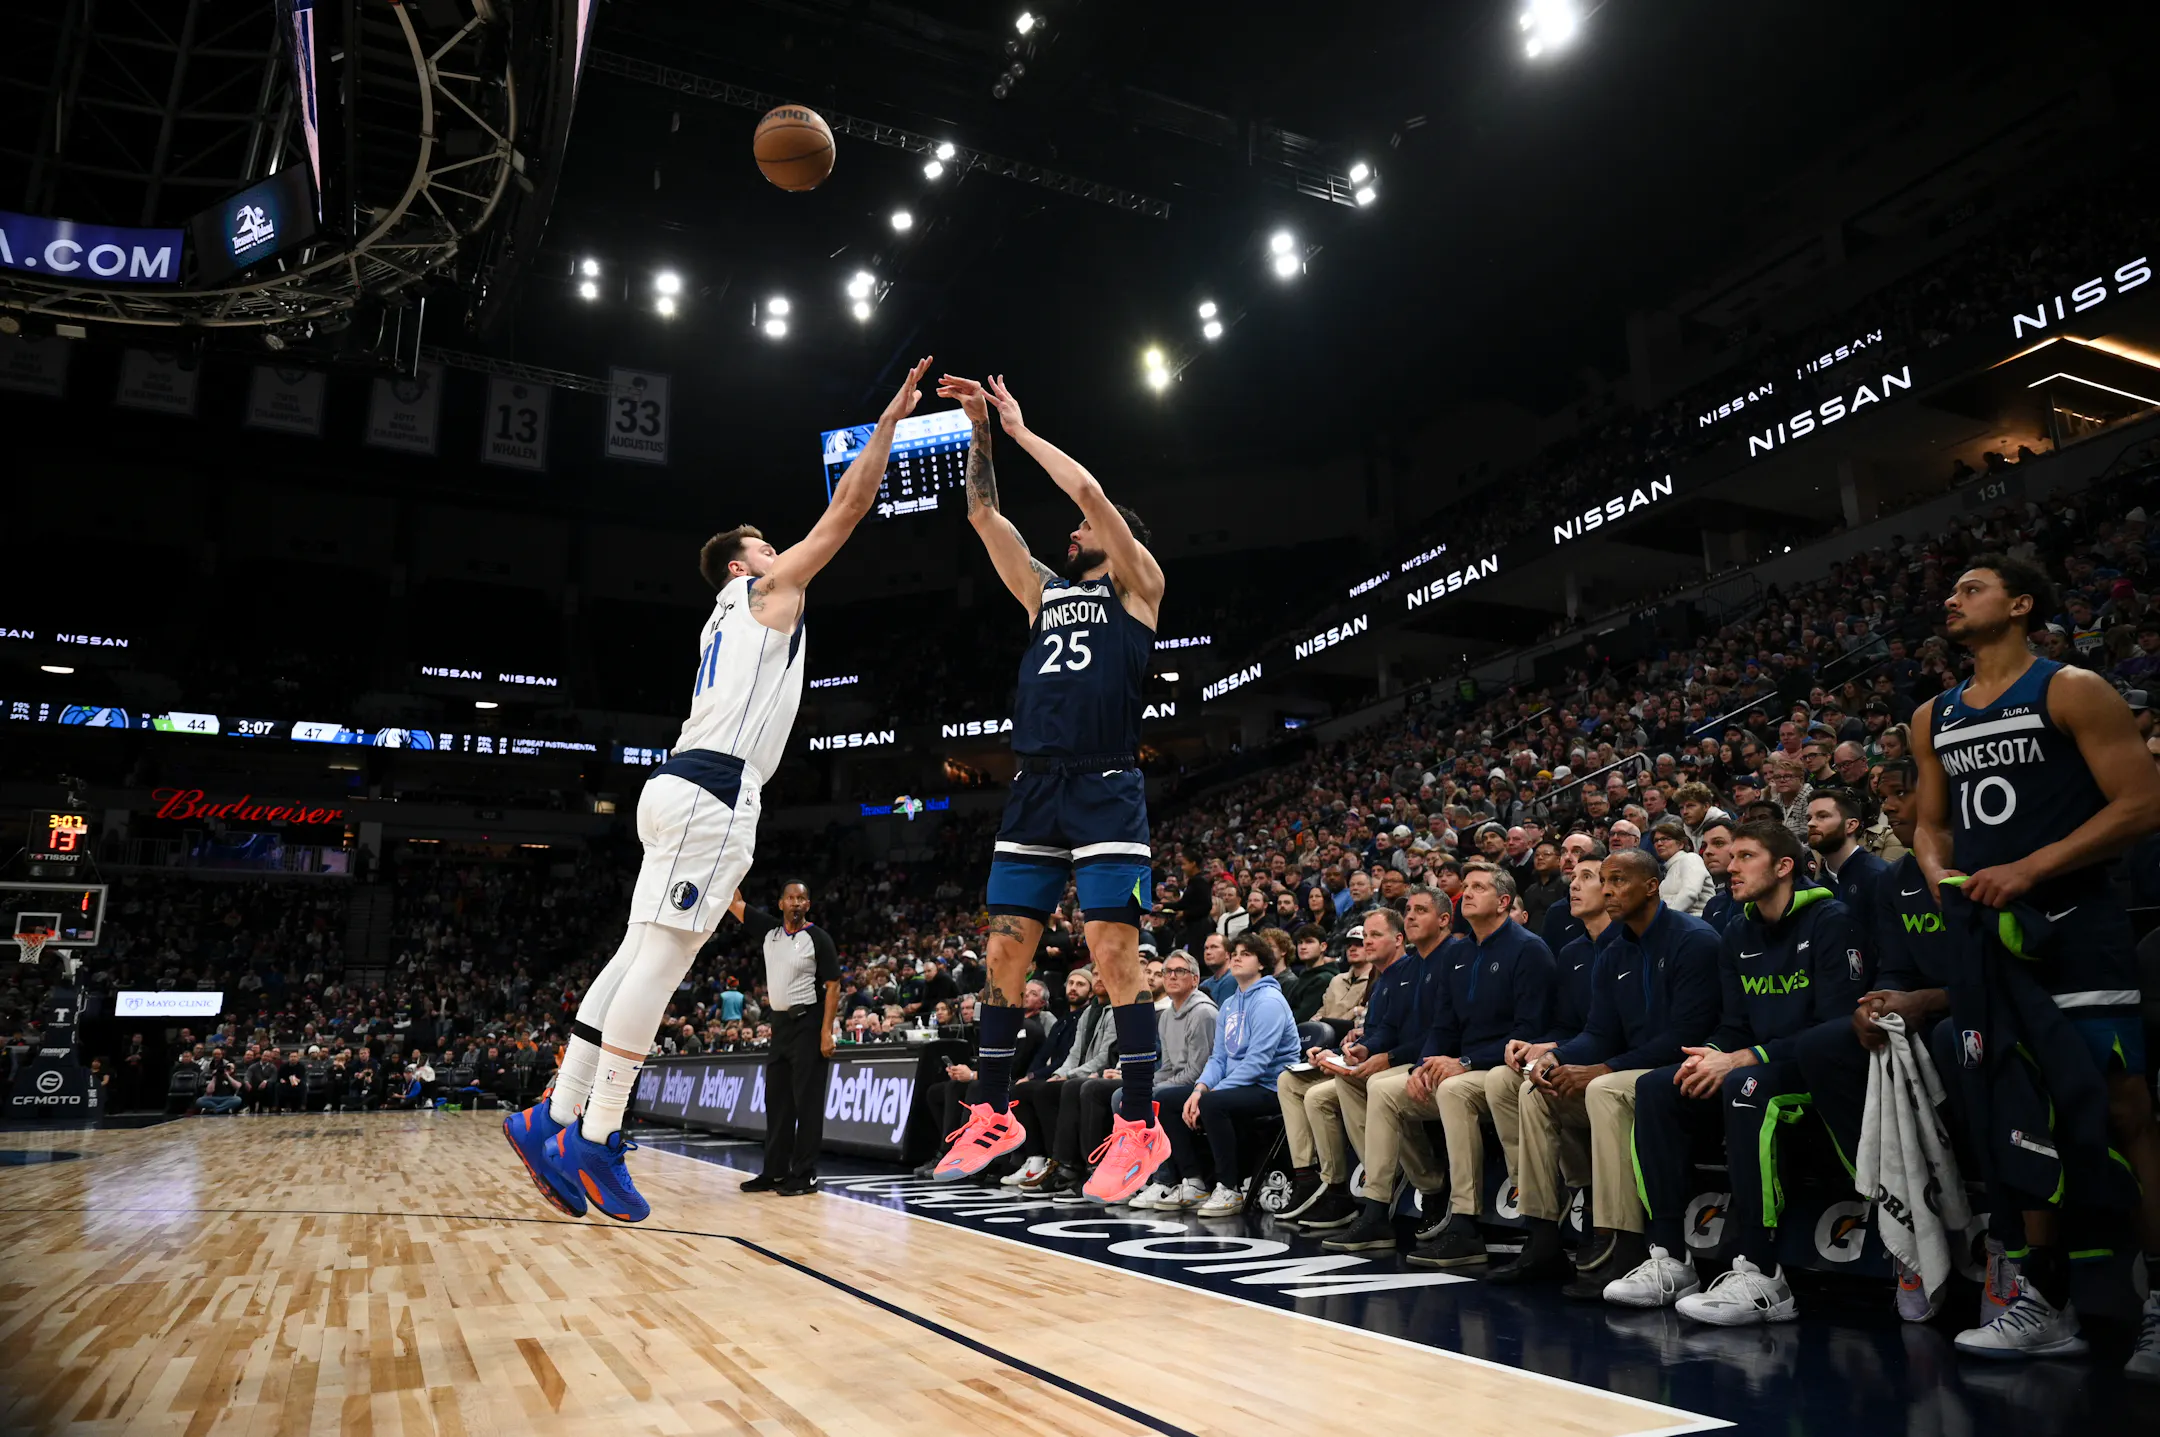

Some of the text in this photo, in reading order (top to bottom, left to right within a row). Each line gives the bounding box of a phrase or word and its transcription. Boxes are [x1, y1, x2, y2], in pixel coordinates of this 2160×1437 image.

[615, 398, 661, 438] 33
[1749, 365, 1912, 458] NISSAN
[495, 404, 539, 444] 13
[492, 441, 538, 461] WHALEN
[610, 435, 664, 454] AUGUSTUS
[1978, 480, 2006, 501] 131
[1552, 474, 1673, 545] NISSAN
[1402, 542, 1447, 573] NISSAN
[1349, 570, 1391, 598] NISSAN
[1407, 554, 1499, 611] NISSAN
[1041, 601, 1109, 632] INNESOTA
[57, 633, 128, 648] NISSAN
[1155, 636, 1213, 650] NISSAN
[1295, 613, 1368, 661] NISSAN
[1038, 630, 1093, 675] 25
[422, 666, 482, 680] NISSAN
[499, 673, 558, 687] NISSAN
[811, 675, 859, 688] NISSAN
[1202, 663, 1262, 702] NISSAN
[1943, 705, 1954, 717] 6
[187, 719, 207, 732] 44
[238, 719, 275, 735] 3:07
[304, 728, 322, 740] 47
[517, 739, 545, 748] UPBEAT
[545, 741, 597, 752] INSTRUMENTAL
[810, 729, 895, 751] NISSAN
[512, 746, 533, 755] MUSIC
[655, 754, 661, 763] 3
[152, 787, 343, 824] Budweiser
[1960, 776, 2017, 830] 10
[49, 814, 83, 829] 3:07
[44, 853, 80, 861] TISSOT
[146, 999, 214, 1008] MAYO CLINIC
[12, 1095, 81, 1105] CFMOTO
[661, 1067, 696, 1117] betway
[699, 1066, 744, 1122] betway
[824, 1063, 915, 1144] betway
